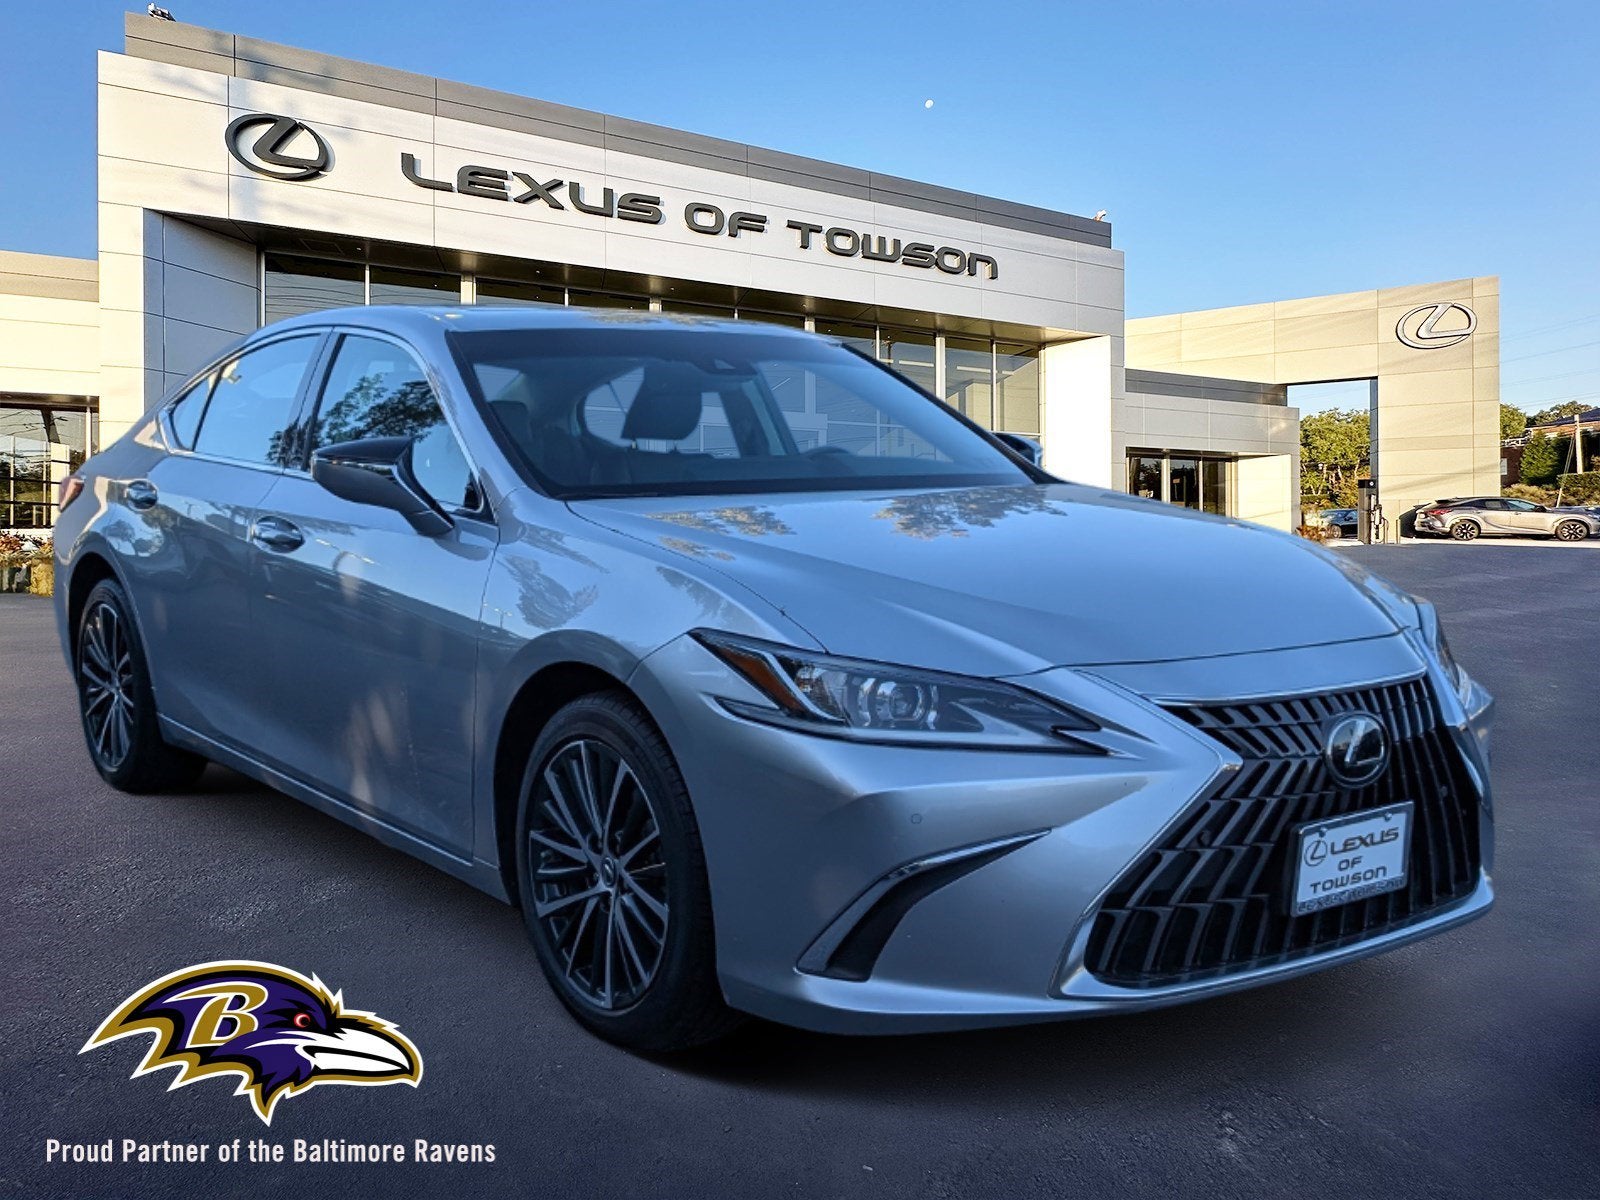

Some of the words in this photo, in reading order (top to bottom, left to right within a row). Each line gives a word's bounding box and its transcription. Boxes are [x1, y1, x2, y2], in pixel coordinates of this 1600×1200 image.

[401, 152, 661, 225] LEXUS
[684, 202, 768, 238] OF
[786, 219, 999, 280] TOWSON
[1330, 827, 1400, 855] LEXUS
[1338, 855, 1363, 872] OF
[1310, 866, 1387, 894] TOWSON
